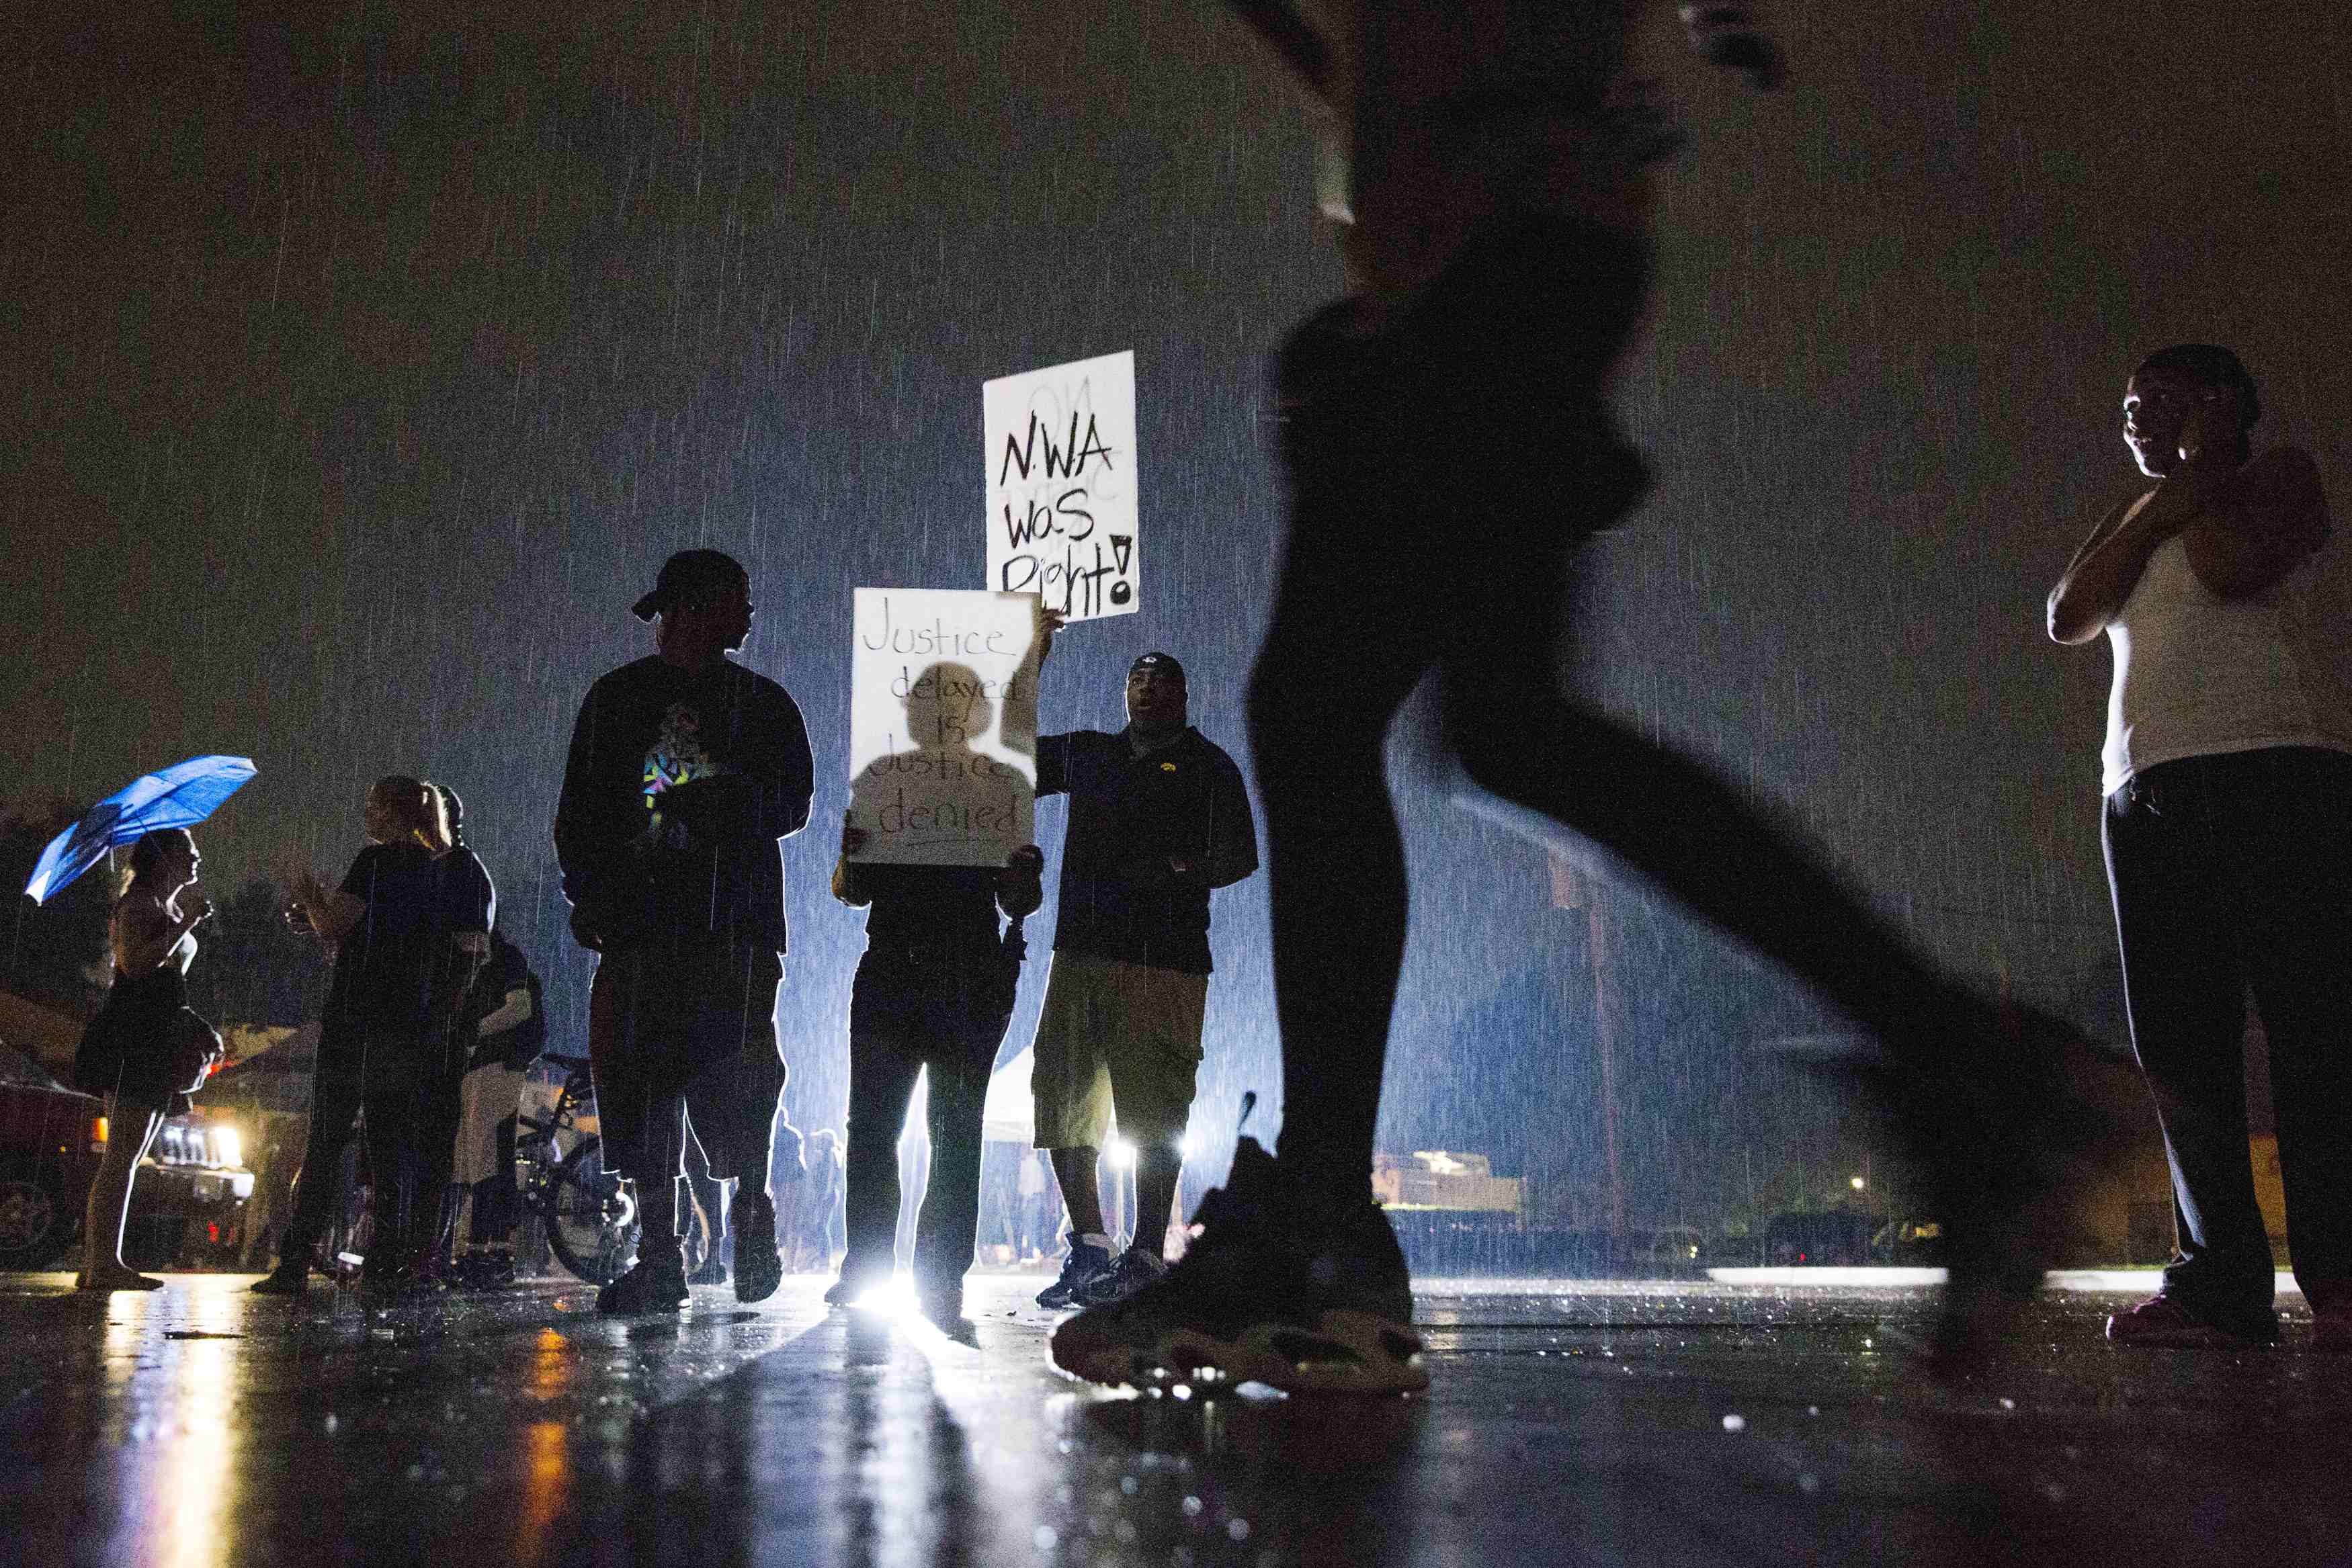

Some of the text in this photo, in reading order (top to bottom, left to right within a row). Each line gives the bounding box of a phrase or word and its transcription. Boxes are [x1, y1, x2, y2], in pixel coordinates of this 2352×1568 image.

[863, 597, 1017, 656] Justice
[891, 666, 1019, 722] delayed
[879, 787, 1017, 834] denied
